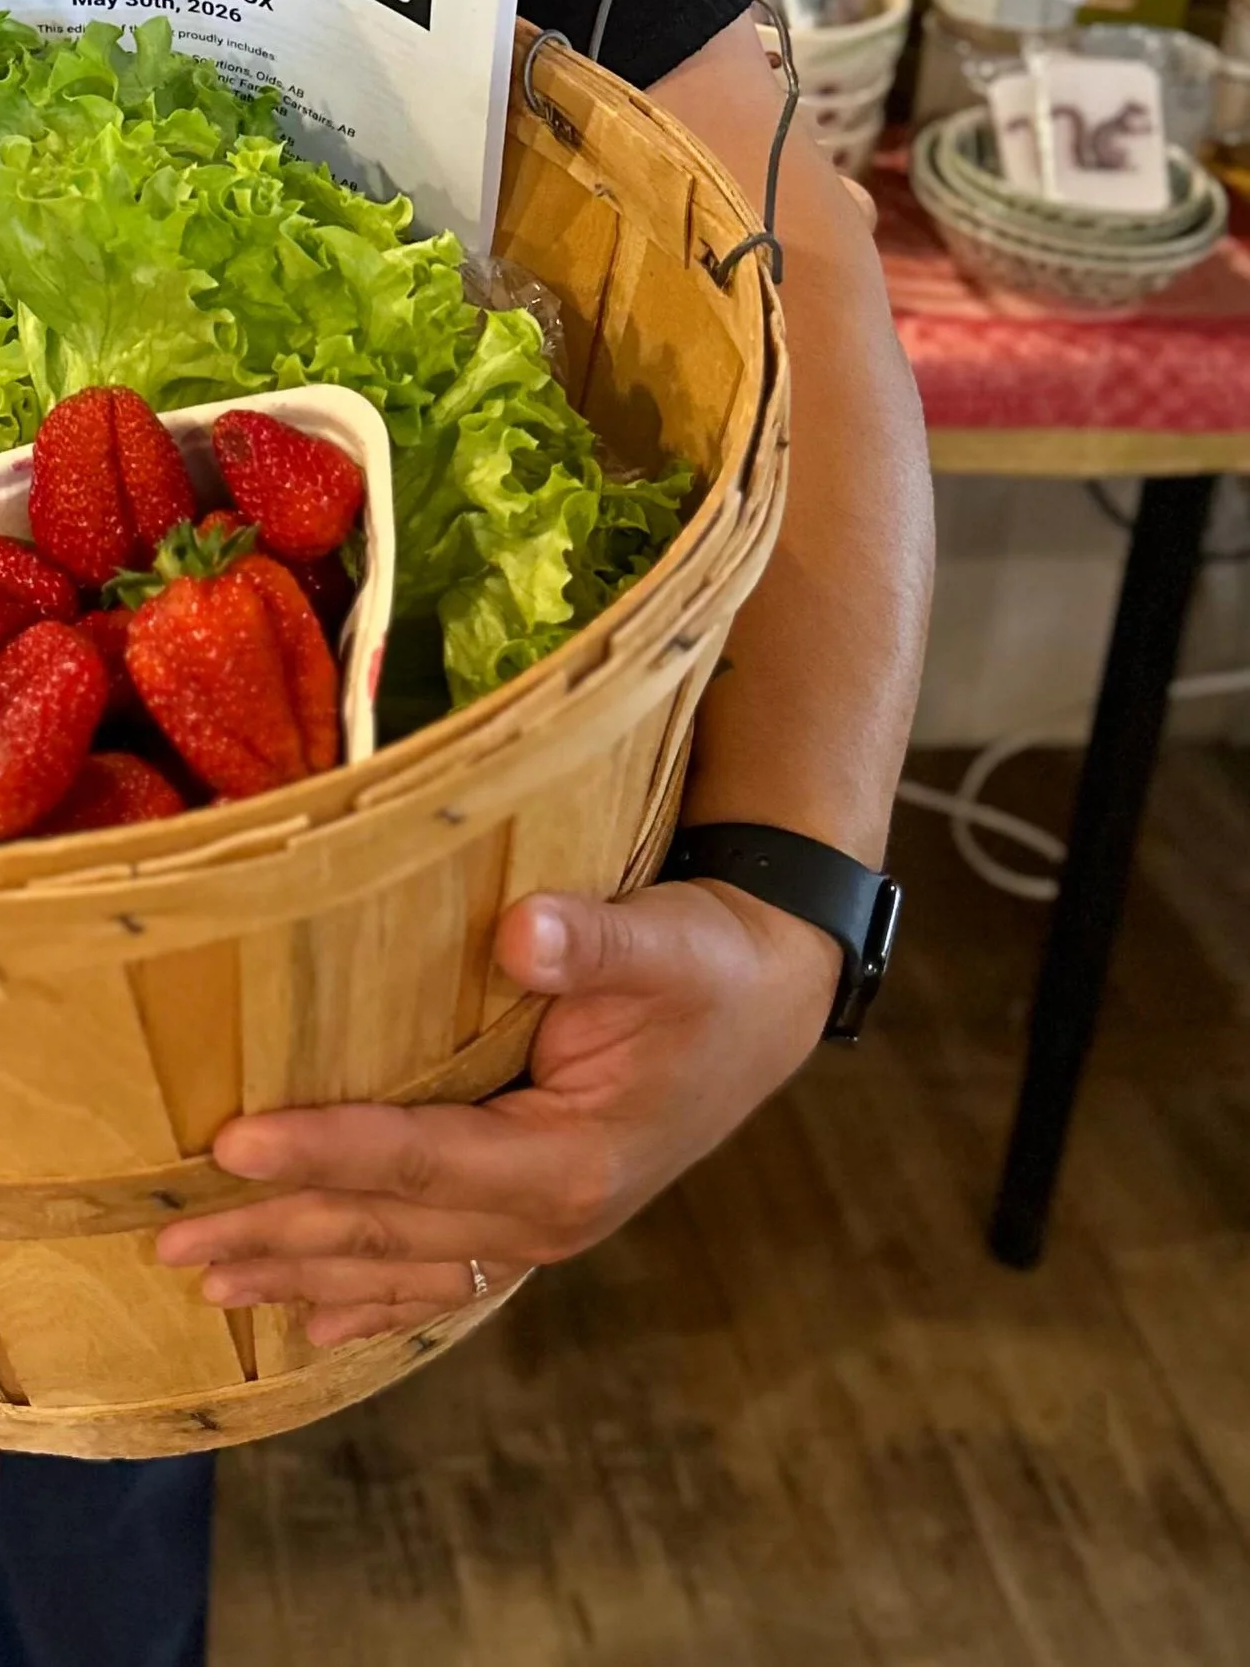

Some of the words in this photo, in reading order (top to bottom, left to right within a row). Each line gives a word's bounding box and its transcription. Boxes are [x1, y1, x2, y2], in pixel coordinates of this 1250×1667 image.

[37, 24, 64, 34] This
[177, 30, 224, 47] proudly
[256, 71, 285, 90] Olds,
[287, 84, 305, 99] AB
[282, 94, 335, 130] Carstairs,
[337, 123, 357, 138] AB
